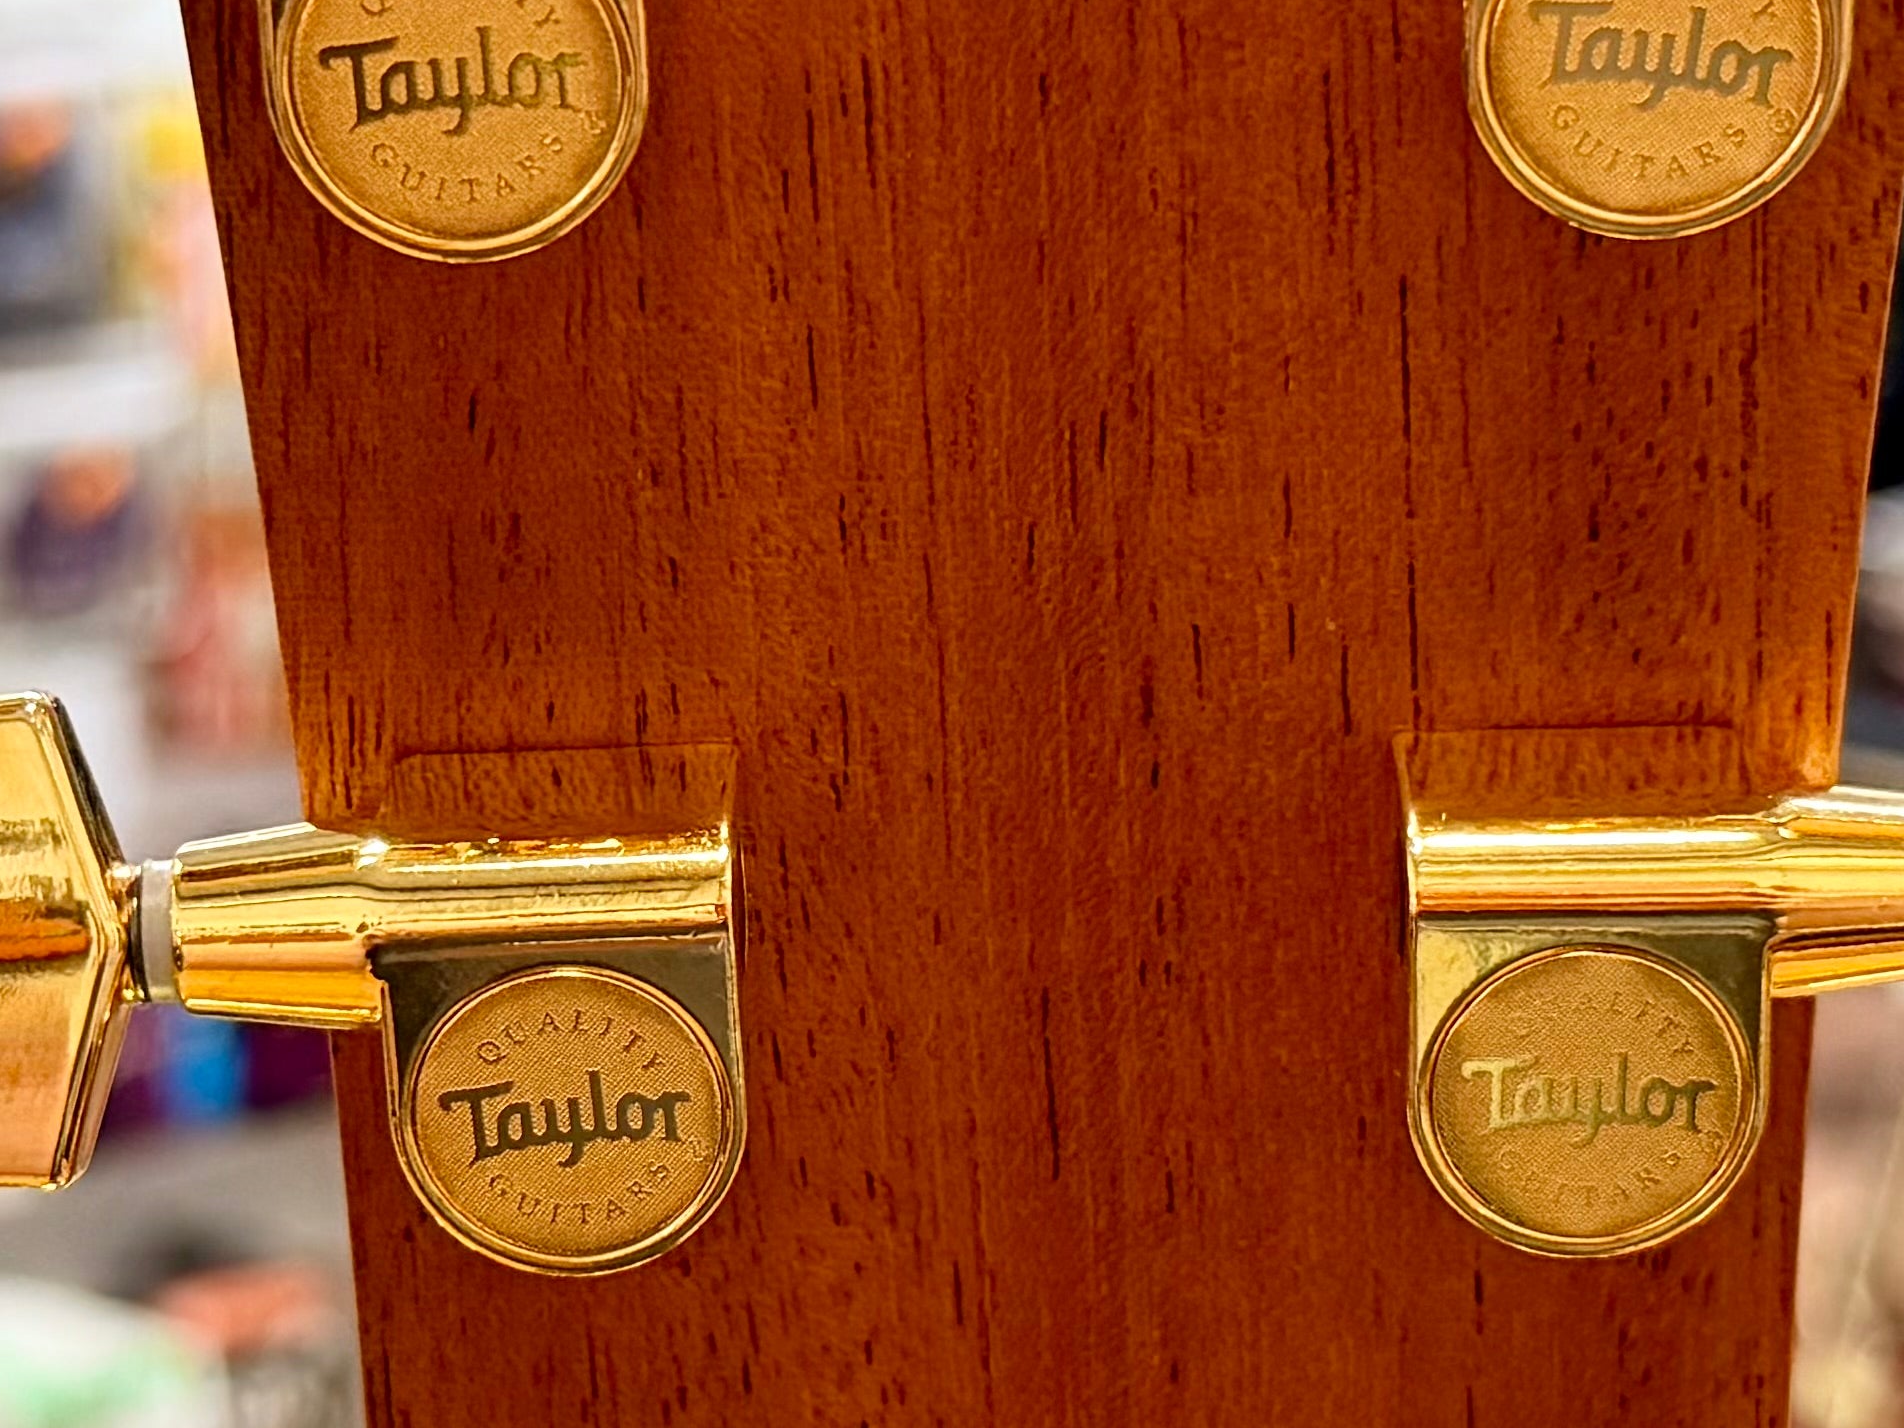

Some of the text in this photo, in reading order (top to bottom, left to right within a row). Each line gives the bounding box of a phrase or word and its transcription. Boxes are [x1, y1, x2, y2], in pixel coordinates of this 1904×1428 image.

[317, 25, 589, 137] Taylor
[370, 134, 564, 203] GUITARS
[1551, 104, 1746, 179] GUITARS
[476, 1009, 667, 1071] QUALITY
[437, 1068, 692, 1169] Taylor
[1461, 1049, 1718, 1149] Taylor
[487, 1160, 670, 1223] GUITARS
